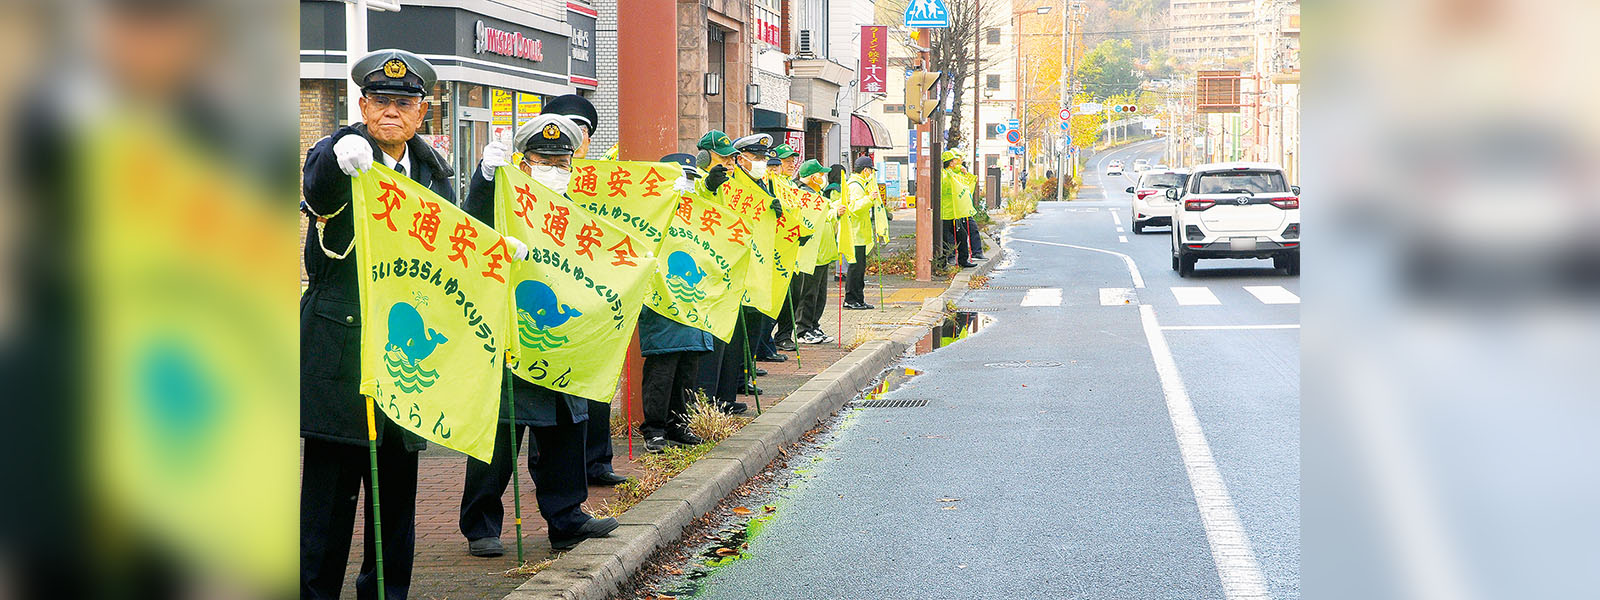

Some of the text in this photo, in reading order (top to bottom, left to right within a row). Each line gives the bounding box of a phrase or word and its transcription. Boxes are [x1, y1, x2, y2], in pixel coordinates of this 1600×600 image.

[863, 64, 883, 92] 十八番
[573, 166, 666, 198] 通安全
[372, 178, 512, 284] 交通安全
[513, 183, 638, 267] 交通安全
[675, 196, 751, 246] 通安全
